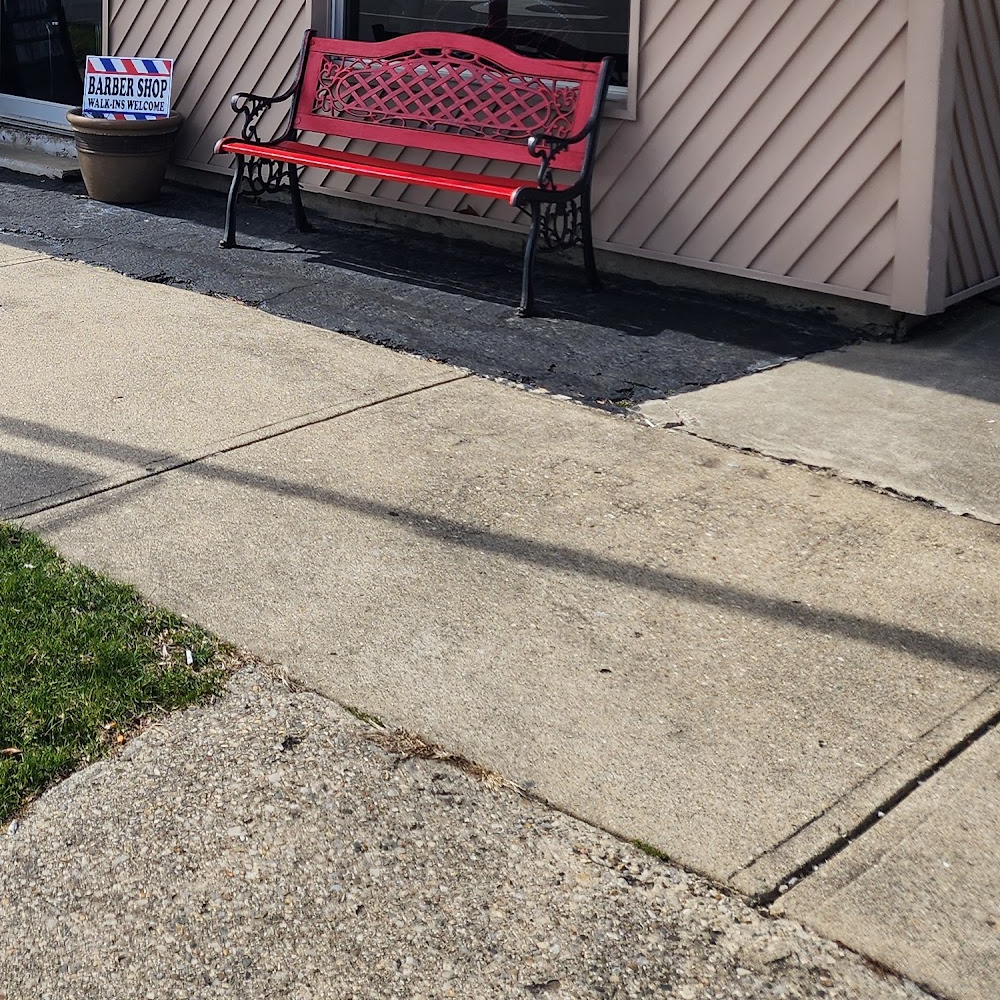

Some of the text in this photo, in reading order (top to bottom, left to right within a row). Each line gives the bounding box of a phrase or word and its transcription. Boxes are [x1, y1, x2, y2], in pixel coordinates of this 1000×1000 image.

[88, 76, 168, 98] BARBER SHOP
[88, 98, 165, 111] WALK-INS WELCOME
